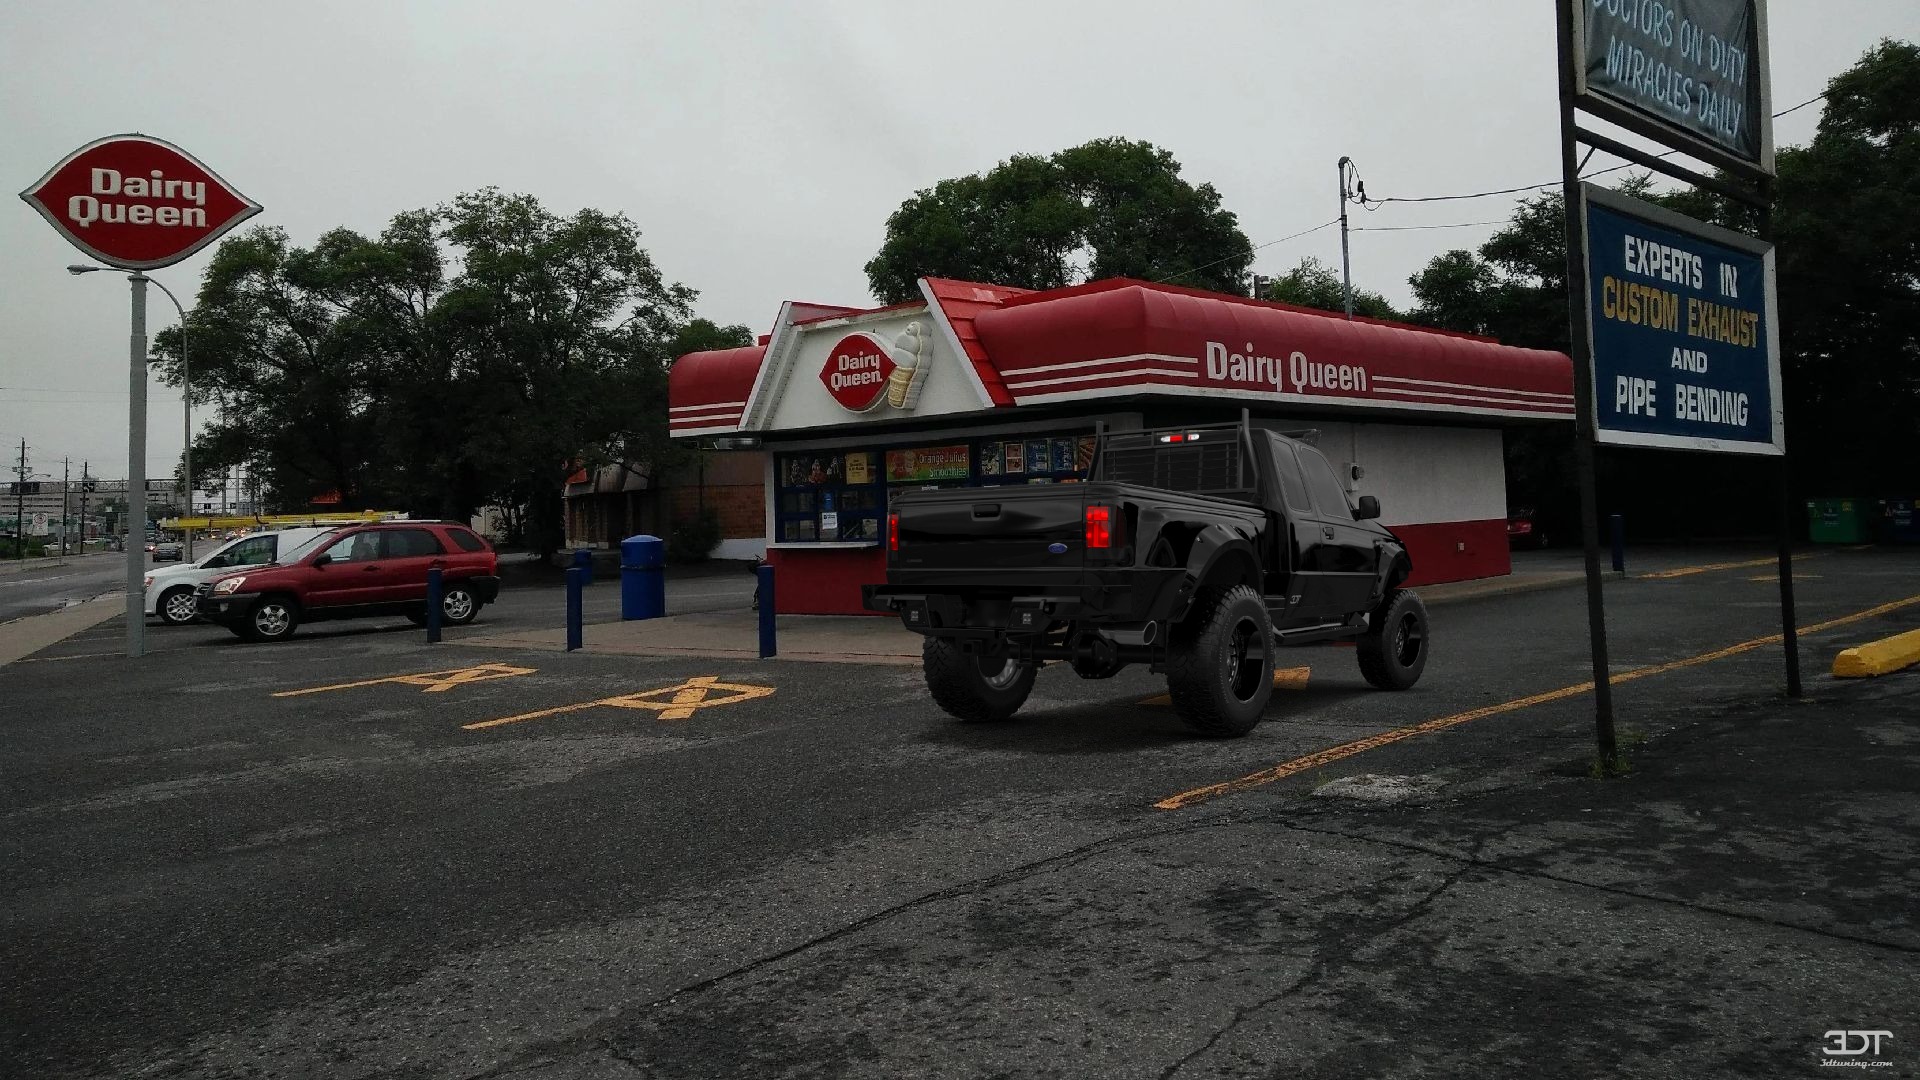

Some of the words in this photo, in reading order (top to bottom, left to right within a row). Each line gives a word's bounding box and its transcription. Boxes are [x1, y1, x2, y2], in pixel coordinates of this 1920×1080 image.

[1592, 0, 1674, 47] CTORS
[1680, 19, 1703, 66] ON
[1709, 34, 1746, 87] DUTY
[1605, 34, 1693, 114] MIRACLES
[1698, 83, 1742, 137] DAILY
[91, 168, 206, 207] Dairy
[68, 195, 207, 228] Queen
[1624, 234, 1703, 289] EXPERTS
[1719, 262, 1738, 298] IN
[1602, 275, 1679, 332] CUSTOM
[1688, 298, 1758, 348] EXHAUST
[838, 351, 880, 370] Dairy
[1206, 341, 1283, 392] Dairy
[1289, 351, 1367, 394] Queen
[1670, 346, 1708, 374] AND
[830, 369, 882, 391] Queen
[1615, 375, 1657, 417] PIPE
[1675, 383, 1749, 427] BENDING
[919, 454, 944, 465] Orange
[945, 452, 966, 463] Julius
[929, 466, 967, 477] Smoothies
